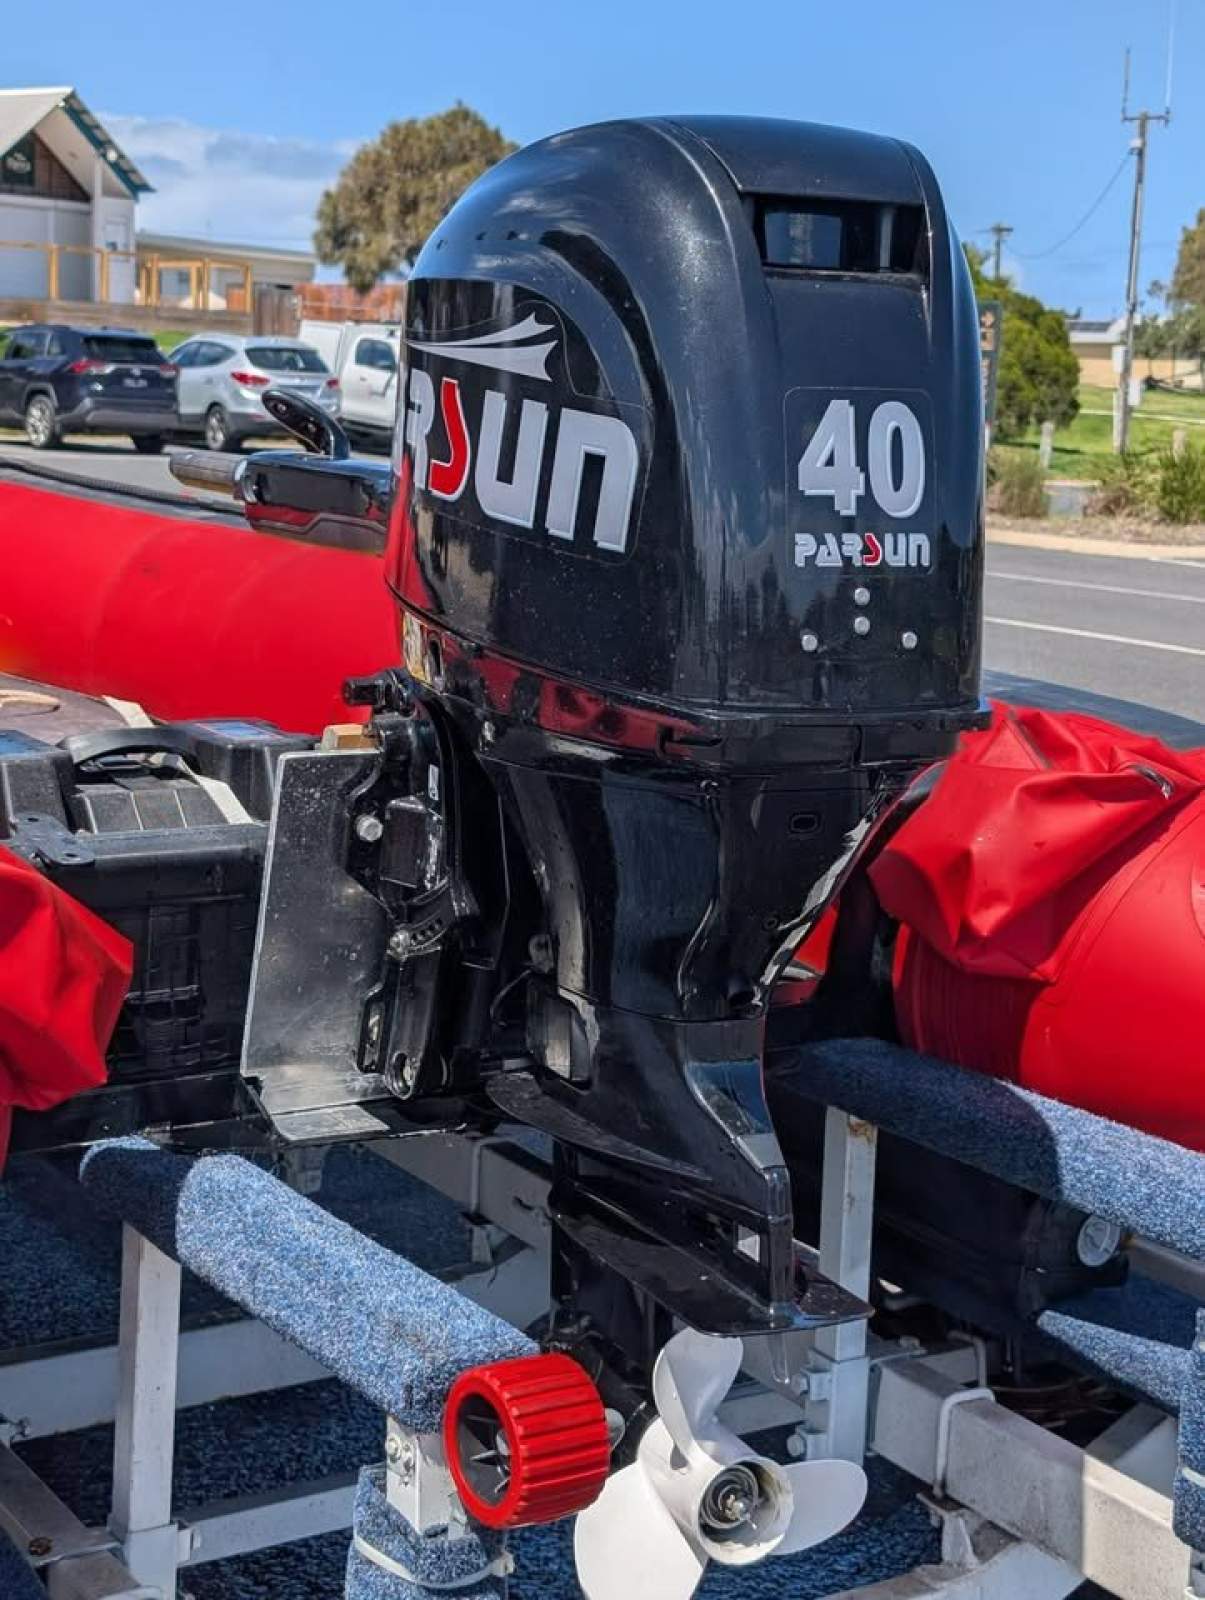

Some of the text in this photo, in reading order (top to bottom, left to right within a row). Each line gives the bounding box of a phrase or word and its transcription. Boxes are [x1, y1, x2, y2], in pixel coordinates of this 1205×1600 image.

[393, 367, 638, 552] RSUN
[798, 399, 925, 518] 40
[794, 532, 931, 567] PARSUN
